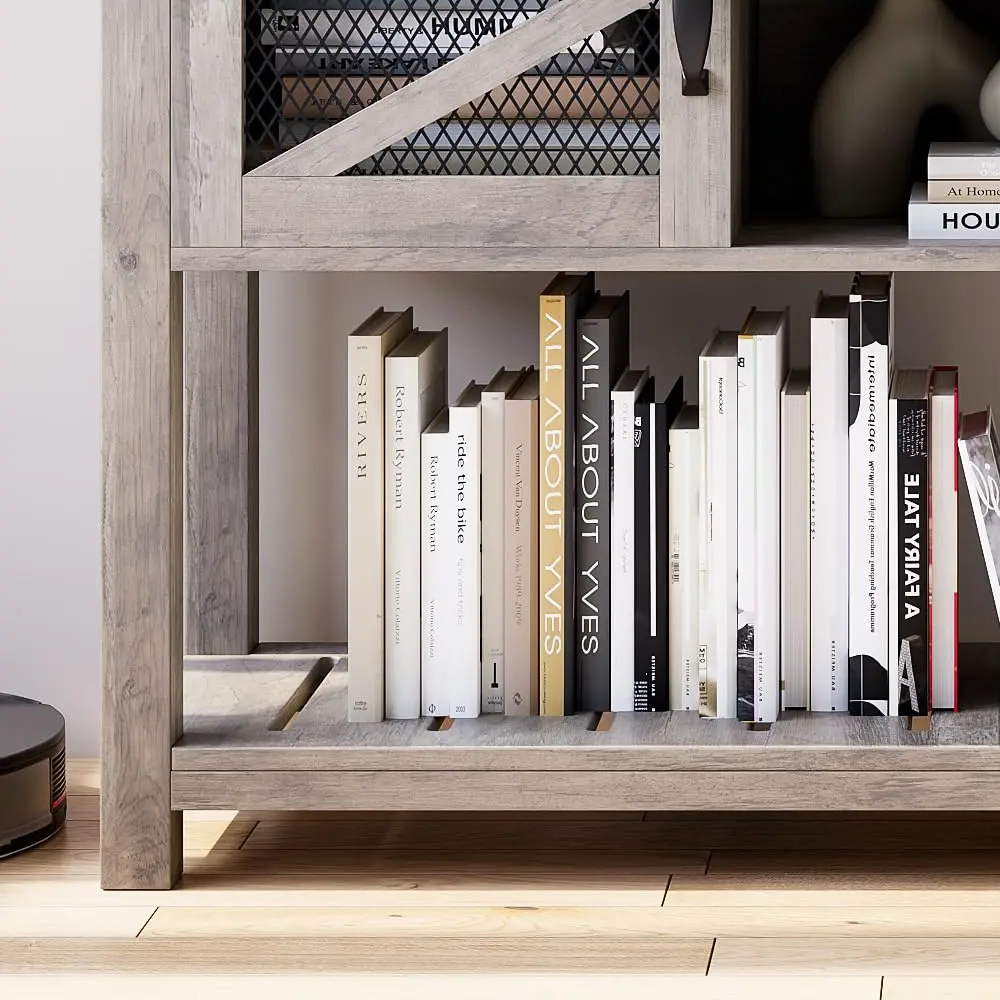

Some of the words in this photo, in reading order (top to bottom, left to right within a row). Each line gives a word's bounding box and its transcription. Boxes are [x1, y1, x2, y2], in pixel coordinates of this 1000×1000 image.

[947, 187, 962, 197] At
[543, 312, 562, 385] ALL
[580, 334, 599, 401] ALL
[356, 373, 368, 479] RIVERS
[394, 385, 406, 443] Robert
[428, 455, 438, 499] Robert
[455, 434, 467, 468] ride
[515, 444, 524, 478] Vincent
[543, 397, 562, 536] ABOUT
[392, 448, 406, 510] Ryman
[455, 474, 467, 502] the
[515, 480, 524, 498] Van
[580, 413, 599, 543] ABOUT
[427, 504, 438, 553] Ryman
[455, 508, 467, 544] bike
[513, 500, 524, 532] Duysen
[543, 555, 562, 656] YVES
[580, 560, 599, 655] YVES
